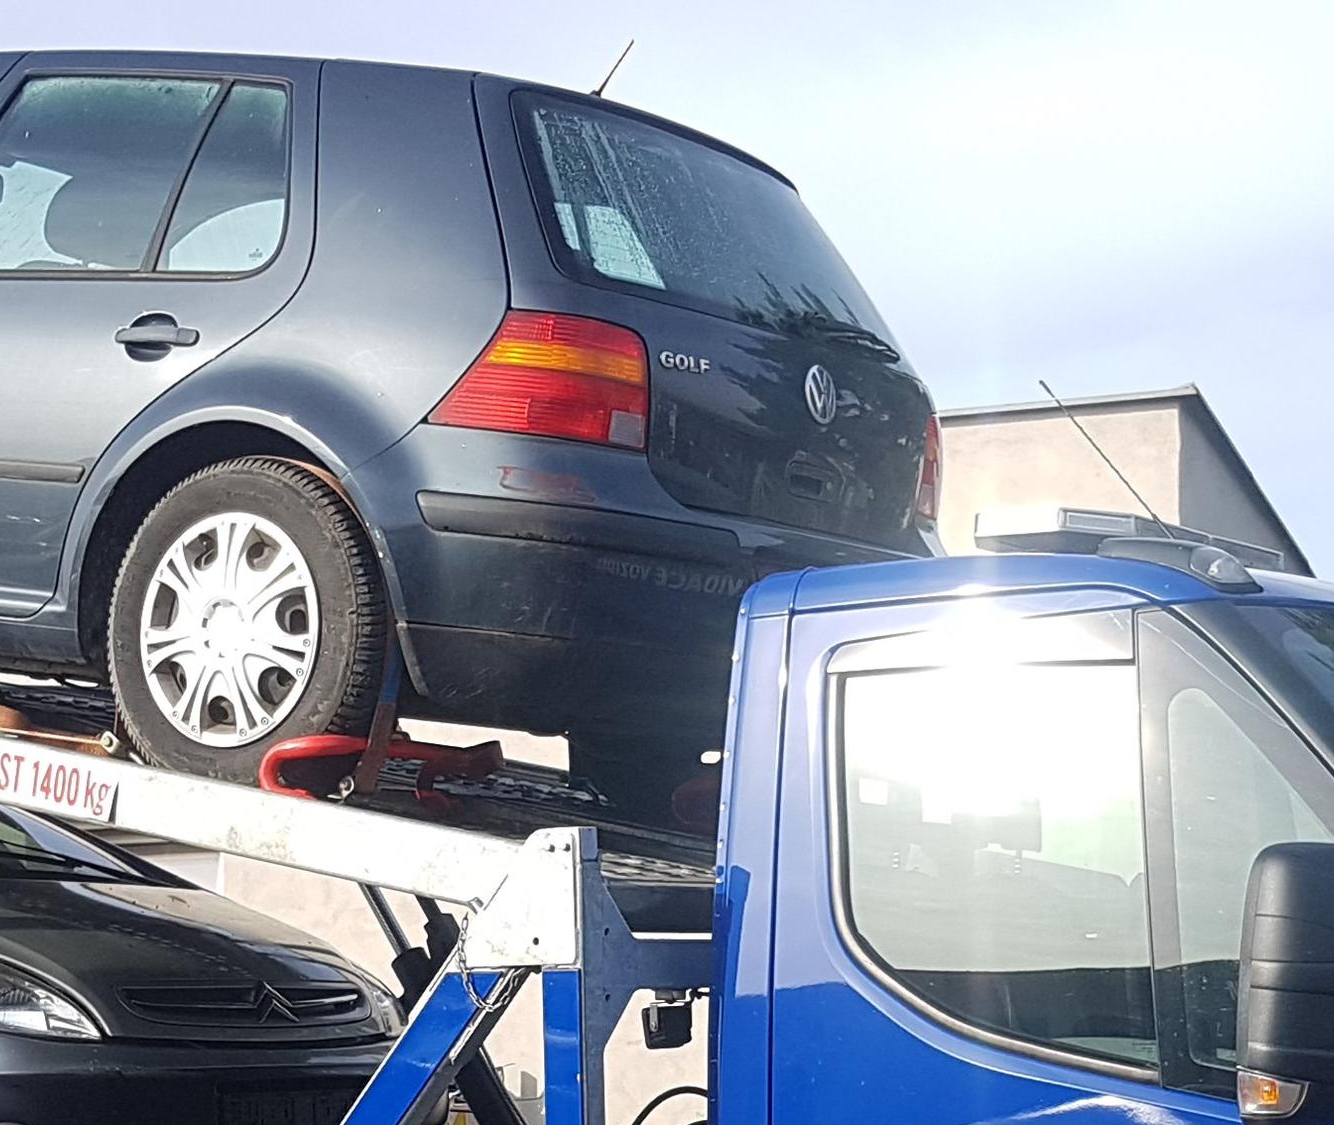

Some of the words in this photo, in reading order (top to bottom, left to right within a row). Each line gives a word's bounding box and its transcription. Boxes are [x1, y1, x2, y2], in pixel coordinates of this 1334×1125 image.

[660, 351, 711, 374] GOLF
[31, 760, 80, 806] 1400
[83, 770, 112, 816] kg
